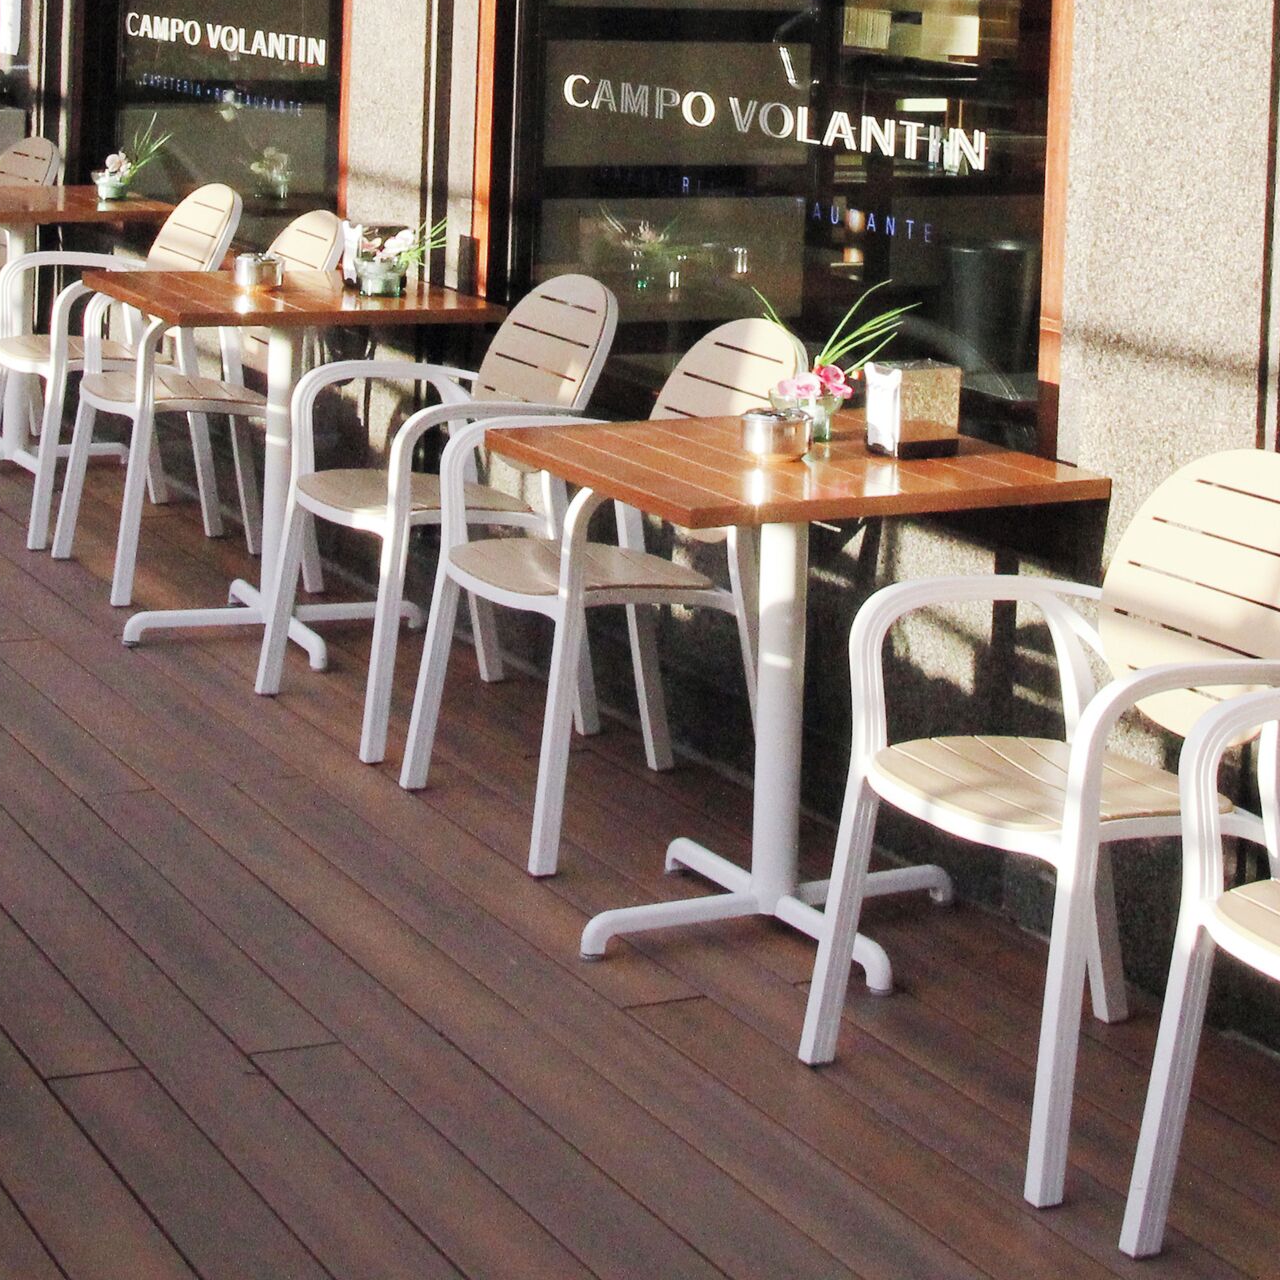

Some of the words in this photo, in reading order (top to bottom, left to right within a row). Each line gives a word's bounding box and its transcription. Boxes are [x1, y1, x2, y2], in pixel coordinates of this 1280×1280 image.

[126, 12, 201, 46] CAMPO
[206, 23, 326, 66] VOLANTIN
[563, 74, 716, 127] CAMPO
[728, 96, 986, 171] VOLANTIN
